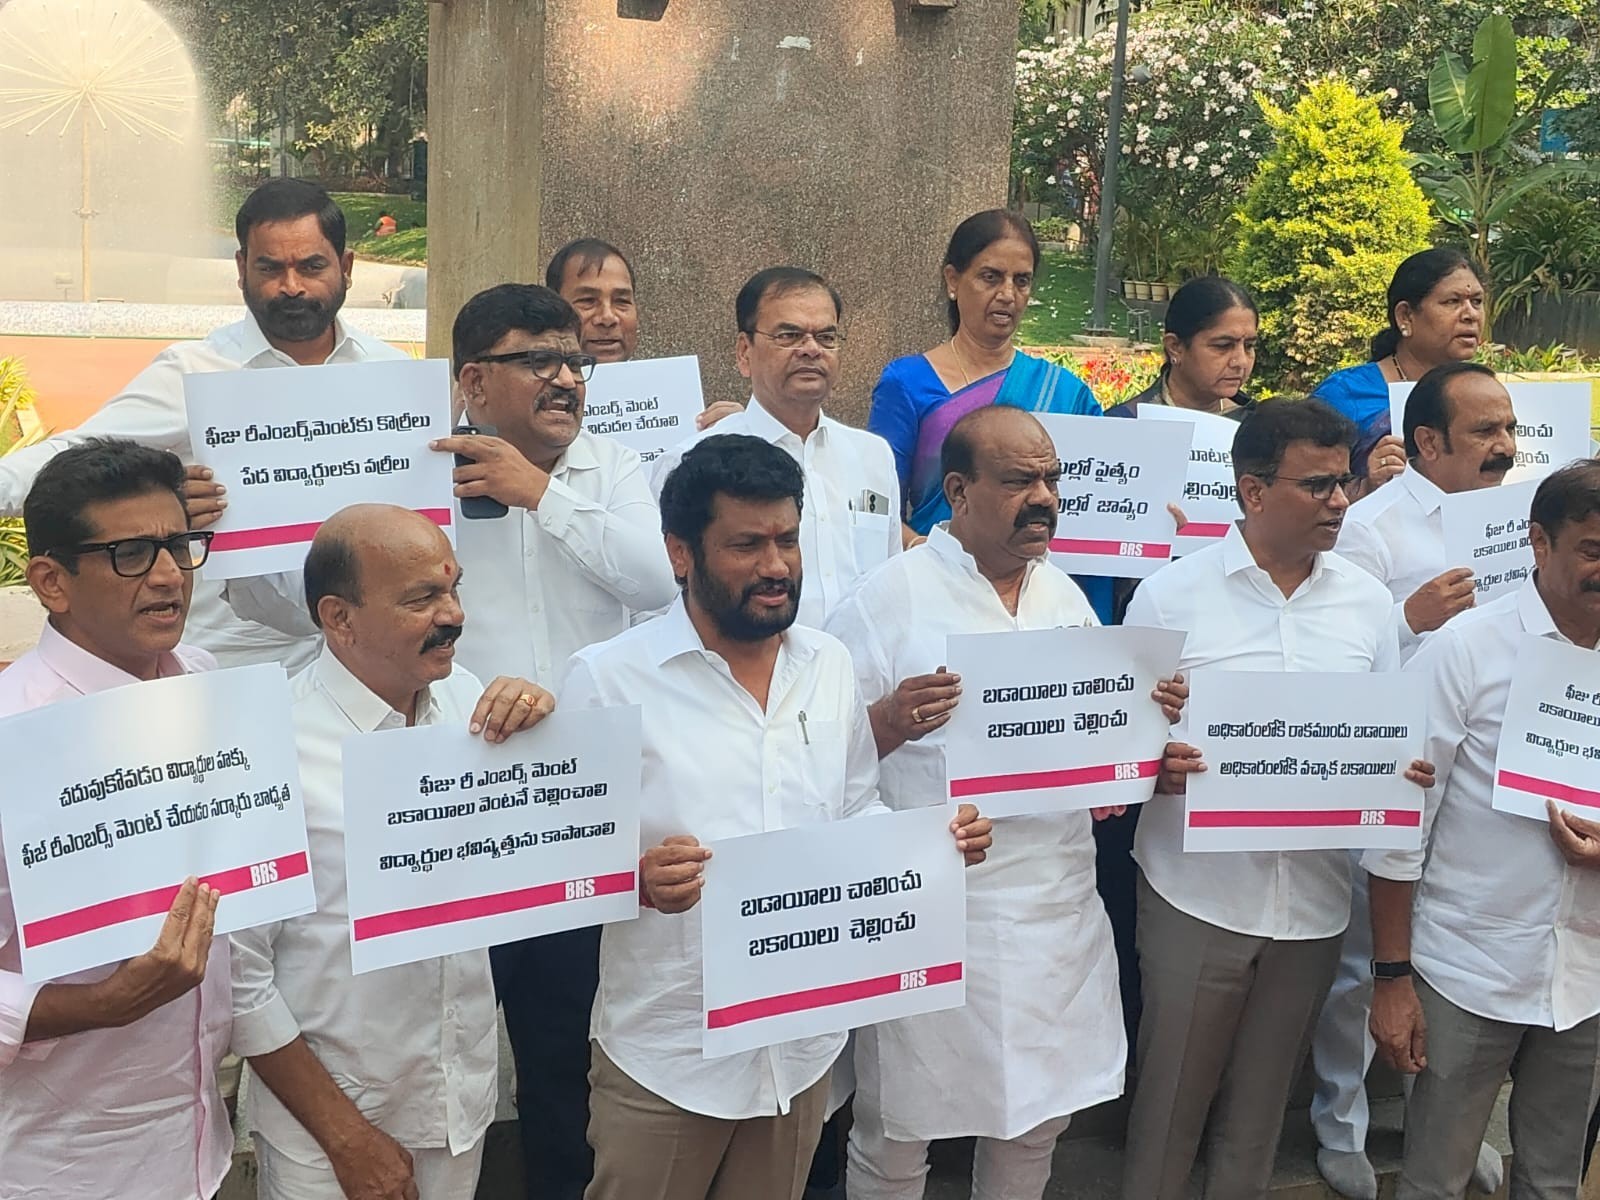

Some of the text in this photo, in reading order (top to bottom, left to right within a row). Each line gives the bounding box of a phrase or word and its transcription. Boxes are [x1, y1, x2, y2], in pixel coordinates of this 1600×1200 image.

[635, 415, 679, 430] చేయాలి
[205, 426, 240, 447] ఫీజు
[240, 466, 269, 486] పేద
[1119, 543, 1143, 556] BRS
[1114, 763, 1140, 780] BRS
[59, 766, 163, 808] చదువుకోవడం
[420, 775, 455, 797] ఫీజు
[479, 787, 528, 813] వెంటనే
[1359, 810, 1386, 825] BRS
[250, 861, 279, 887] BRS
[846, 870, 922, 900] చాలించు
[564, 878, 596, 901] BRS
[849, 911, 916, 944] చెల్లించు
[899, 969, 928, 991] BRS
